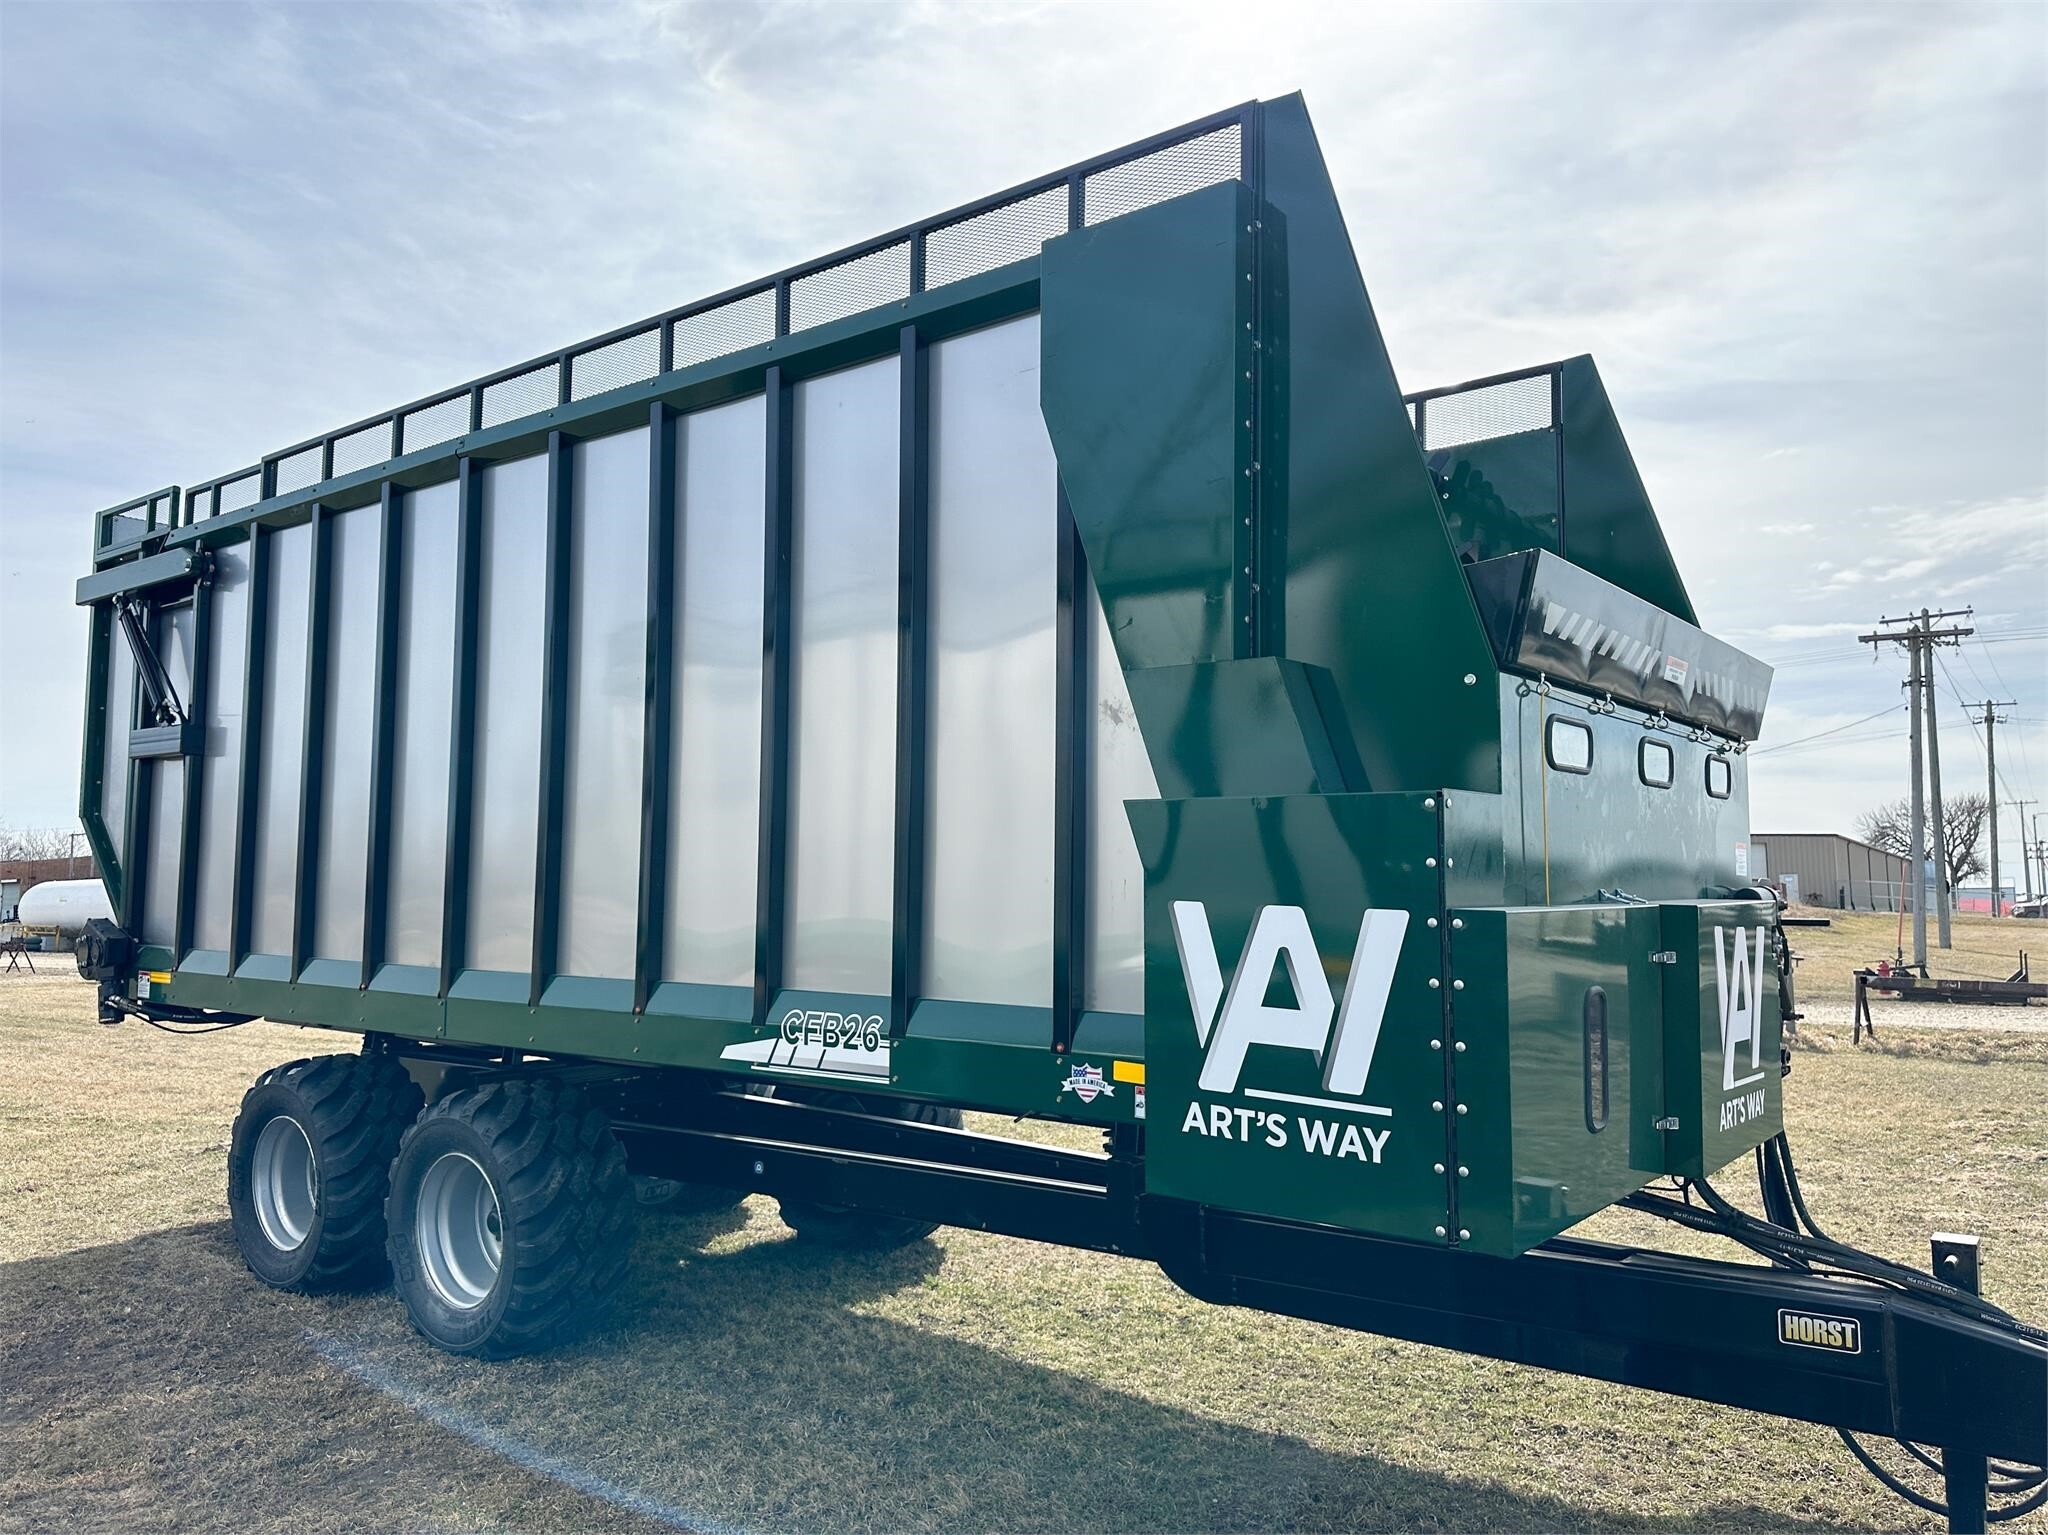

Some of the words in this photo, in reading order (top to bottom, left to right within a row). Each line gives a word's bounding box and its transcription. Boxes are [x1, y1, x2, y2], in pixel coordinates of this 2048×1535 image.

[780, 1009, 885, 1053] CFB26
[1069, 1078, 1080, 1086] MADE
[1087, 1078, 1106, 1089] AMERICA
[1719, 1096, 1746, 1132] ART'S
[1746, 1088, 1766, 1120] WAY
[1182, 1101, 1288, 1149] ART'S
[1298, 1117, 1392, 1164] WAY
[1784, 1314, 1856, 1348] HORST
